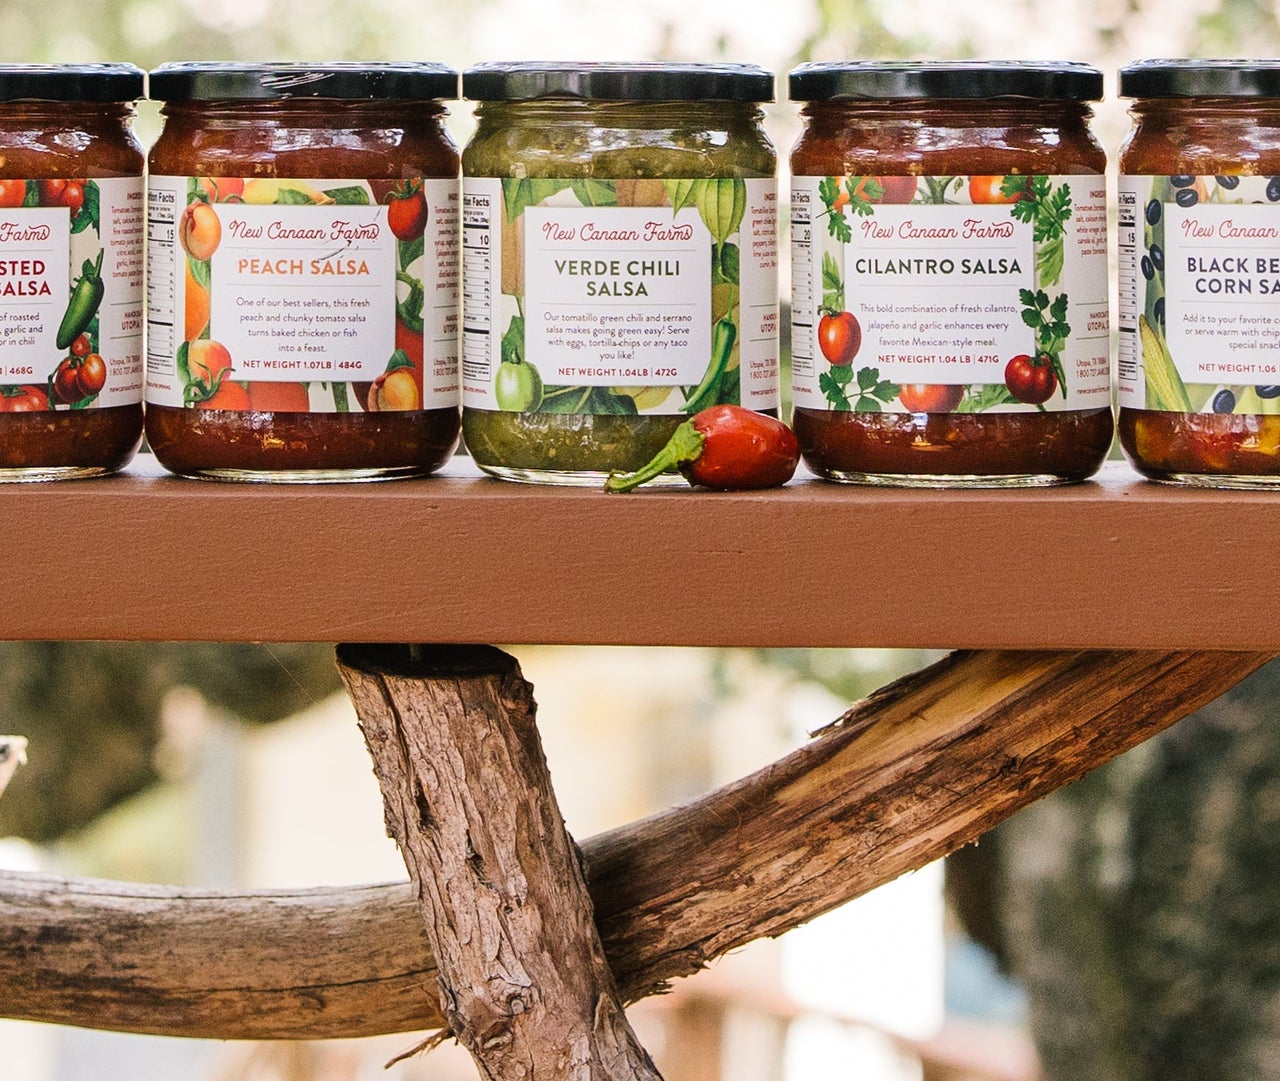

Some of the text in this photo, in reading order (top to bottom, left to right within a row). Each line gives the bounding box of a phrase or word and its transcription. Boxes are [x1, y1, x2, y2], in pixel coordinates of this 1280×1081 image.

[158, 192, 174, 203] Facts
[472, 197, 489, 207] Facts
[0, 222, 50, 242] Farms
[229, 220, 379, 240] New Canaan Farms
[542, 221, 693, 241] New Canaan Farms
[861, 219, 1014, 239] New Canaan Farms
[1181, 218, 1214, 237] New
[1219, 220, 1278, 238] Canaan
[166, 229, 174, 240] 15
[480, 235, 489, 245] 10
[239, 259, 370, 275] PEACH SALSA
[555, 260, 679, 276] VERDE CHILI
[856, 259, 1022, 274] CILANTRO SALSA
[1188, 257, 1249, 273] BLACK
[587, 281, 648, 296] SALSA
[1196, 278, 1251, 294] CORN
[236, 297, 254, 306] One
[256, 297, 265, 306] of
[283, 298, 300, 307] best
[333, 298, 348, 308] this
[350, 298, 370, 308] fresh
[860, 303, 875, 312] This
[877, 304, 893, 312] bold
[895, 304, 947, 313] combination
[949, 304, 959, 313] of
[960, 304, 982, 313] fresh
[9, 312, 39, 321] roasted
[240, 314, 263, 323] peach
[266, 314, 280, 322] and
[283, 314, 314, 325] chunky
[348, 314, 366, 322] salsa
[544, 312, 559, 321] Our
[562, 313, 598, 322] tomatillo
[600, 316, 624, 325] green
[626, 313, 643, 322] chili
[645, 313, 660, 322] and
[1183, 314, 1198, 322] Add
[1218, 317, 1236, 326] your
[1239, 315, 1271, 324] favorite
[4, 326, 26, 336] garlic
[546, 325, 563, 333] salsa
[565, 326, 590, 334] makes
[593, 328, 616, 337] going
[618, 329, 642, 338] green
[667, 325, 690, 334] Serve
[867, 320, 1009, 333] jalapeño and garlic enhances every
[1241, 328, 1259, 336] with
[271, 328, 295, 337] baked
[298, 328, 330, 337] chicken
[343, 328, 358, 337] fish
[9, 337, 16, 345] in
[18, 337, 35, 345] chili
[654, 341, 669, 349] any
[879, 337, 909, 346] favorite
[1229, 341, 1257, 351] special
[599, 353, 615, 361] you
[878, 355, 895, 363] NET
[898, 355, 936, 363] WEIGHT
[960, 355, 971, 363] LB
[978, 355, 999, 363] 471G
[243, 360, 260, 368] NET
[304, 361, 332, 369] 1.07LB
[338, 361, 362, 369] 484G
[1199, 363, 1215, 371] NET
[1218, 364, 1255, 372] WEIGHT
[1258, 365, 1276, 373] 1.06
[9, 366, 33, 375] 468G
[578, 368, 616, 376] WEIGHT
[619, 368, 648, 376] 1.04LB
[655, 368, 677, 376] 472G
